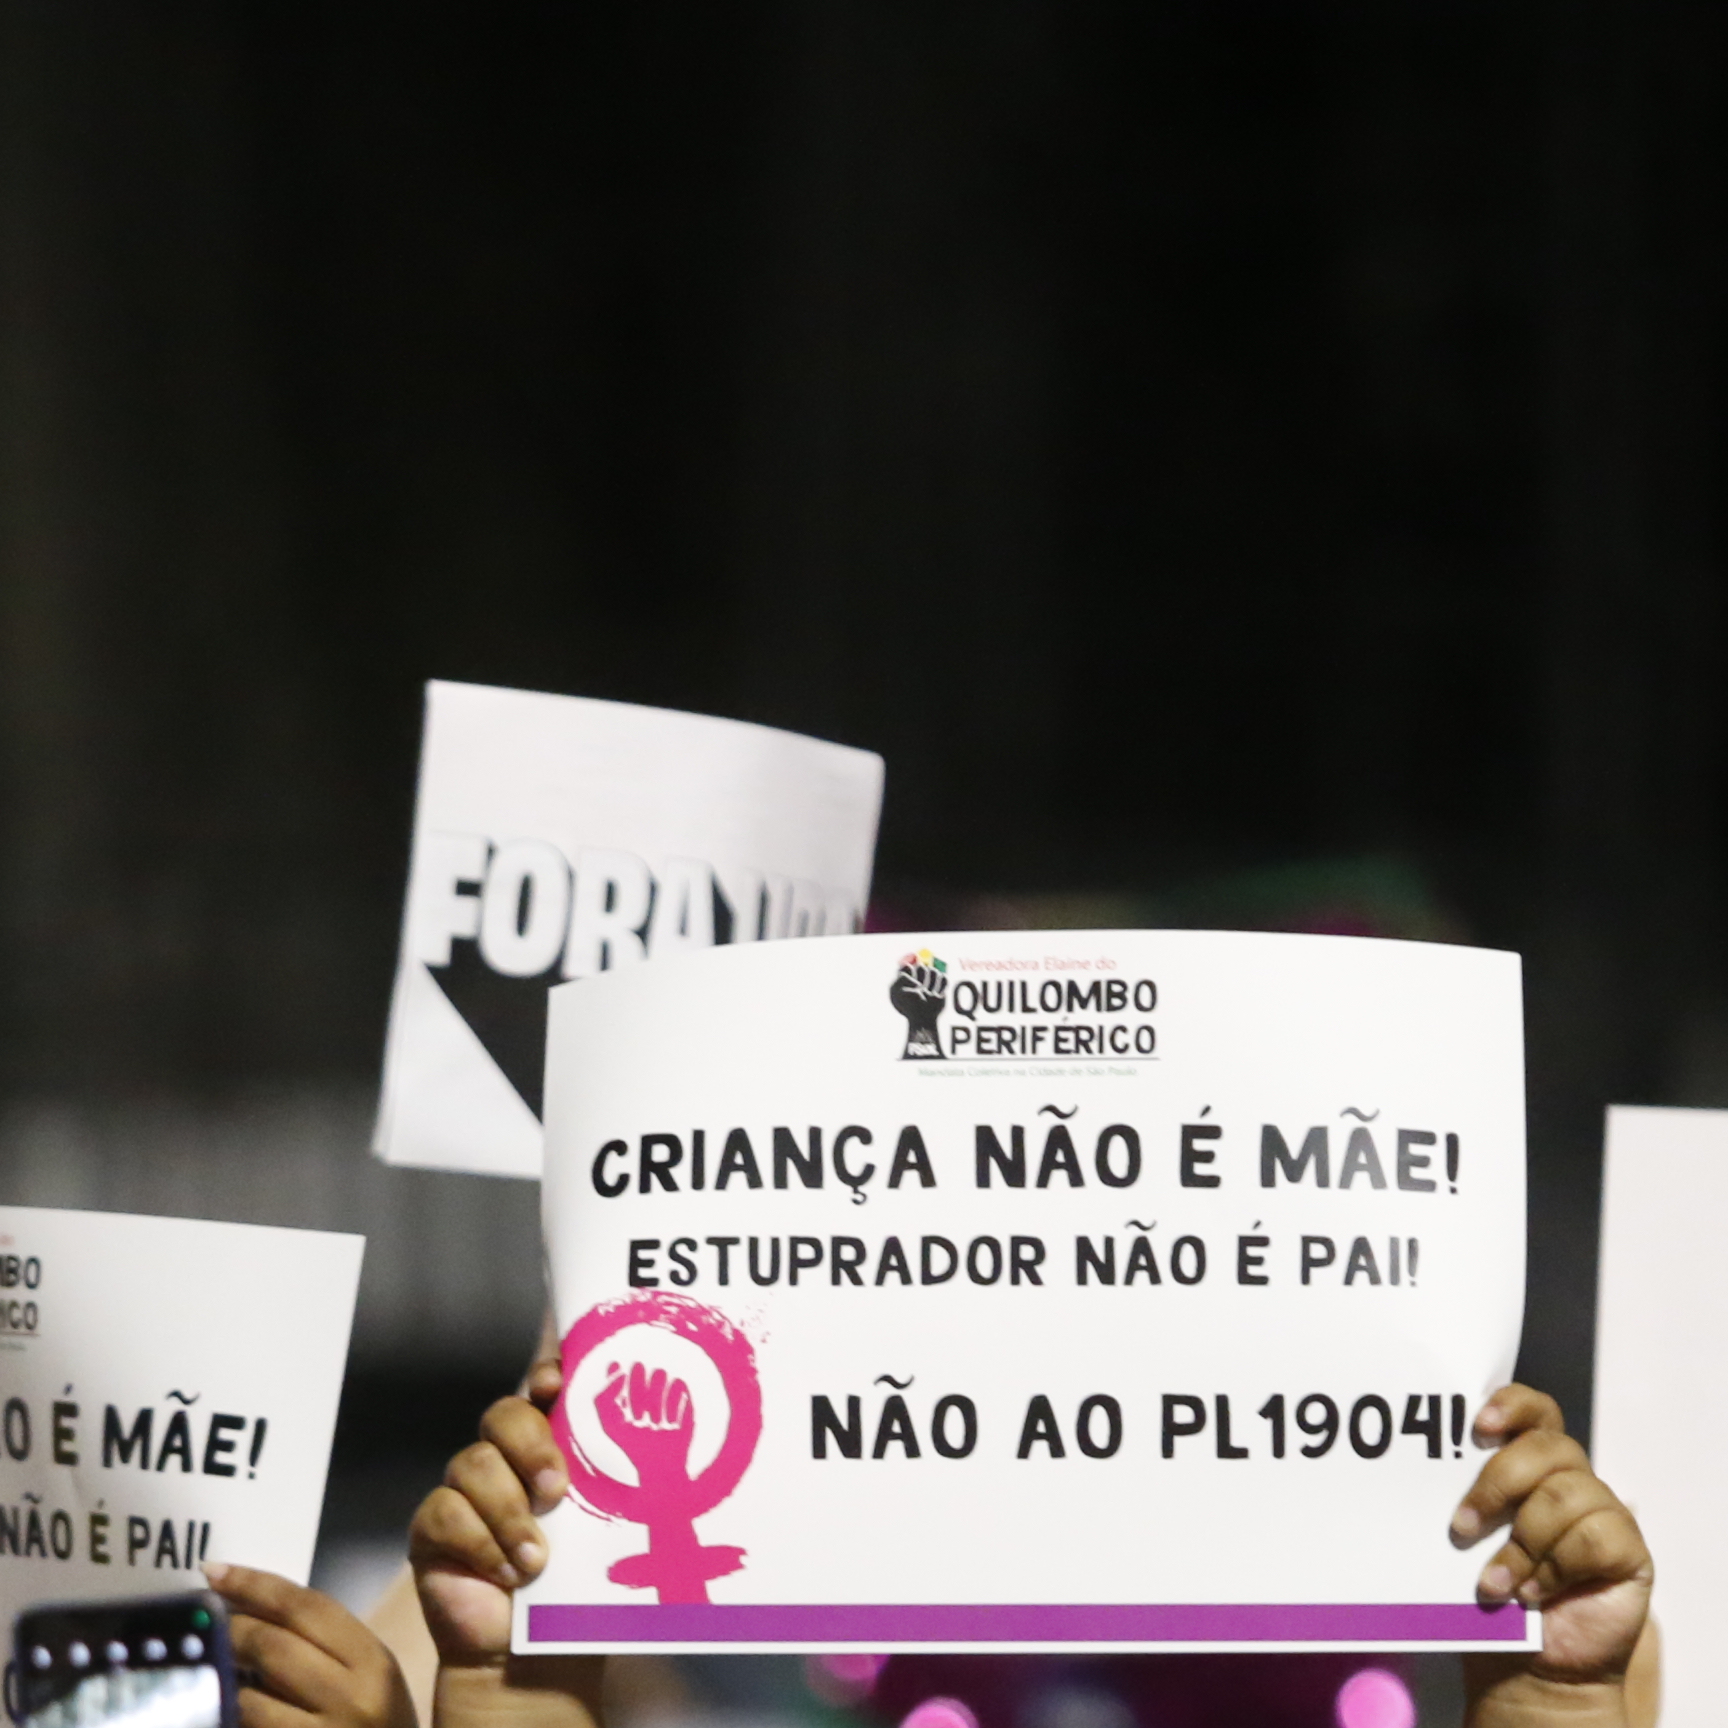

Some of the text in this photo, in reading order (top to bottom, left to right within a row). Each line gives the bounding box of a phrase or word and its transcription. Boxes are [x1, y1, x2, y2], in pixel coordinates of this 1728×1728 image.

[415, 830, 718, 979] FORA
[950, 1016, 1157, 1056] PERIFÉRICO
[952, 978, 1158, 1022] QUILOMBO
[591, 1103, 1460, 1206] CRIANÇA NÃO É MÃE!
[626, 1219, 1419, 1289] ESTUPRADOR NÃO É PAI!
[50, 1383, 80, 1467] É
[100, 1389, 268, 1480] MÃE!
[810, 1374, 1466, 1460] NÃO AO PL1904!
[88, 1501, 112, 1565] É
[125, 1515, 211, 1570] PAI!
